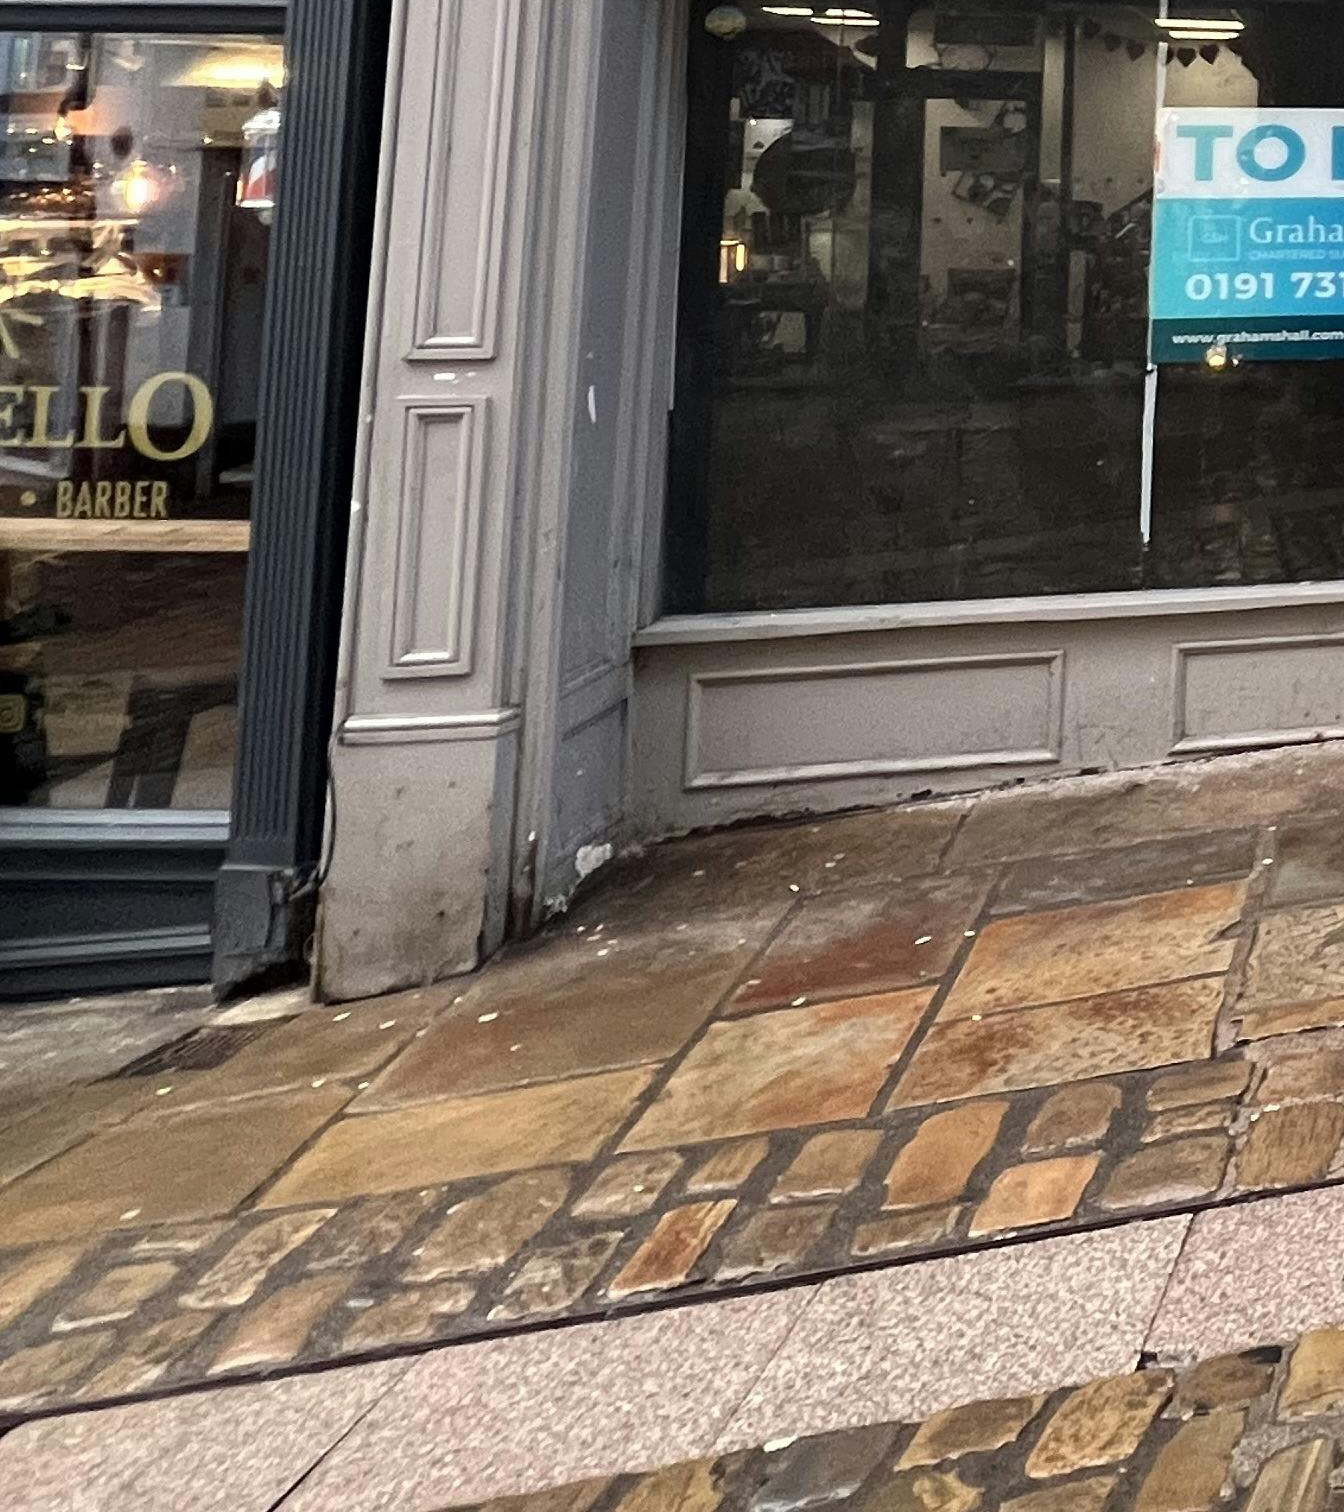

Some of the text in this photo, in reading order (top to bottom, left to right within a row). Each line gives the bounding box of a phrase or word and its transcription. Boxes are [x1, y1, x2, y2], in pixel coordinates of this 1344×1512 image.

[1176, 124, 1306, 182] TO
[1185, 272, 1274, 300] 0191
[1172, 329, 1344, 345] www.grahamshall.com
[56, 480, 170, 518] BARBER
